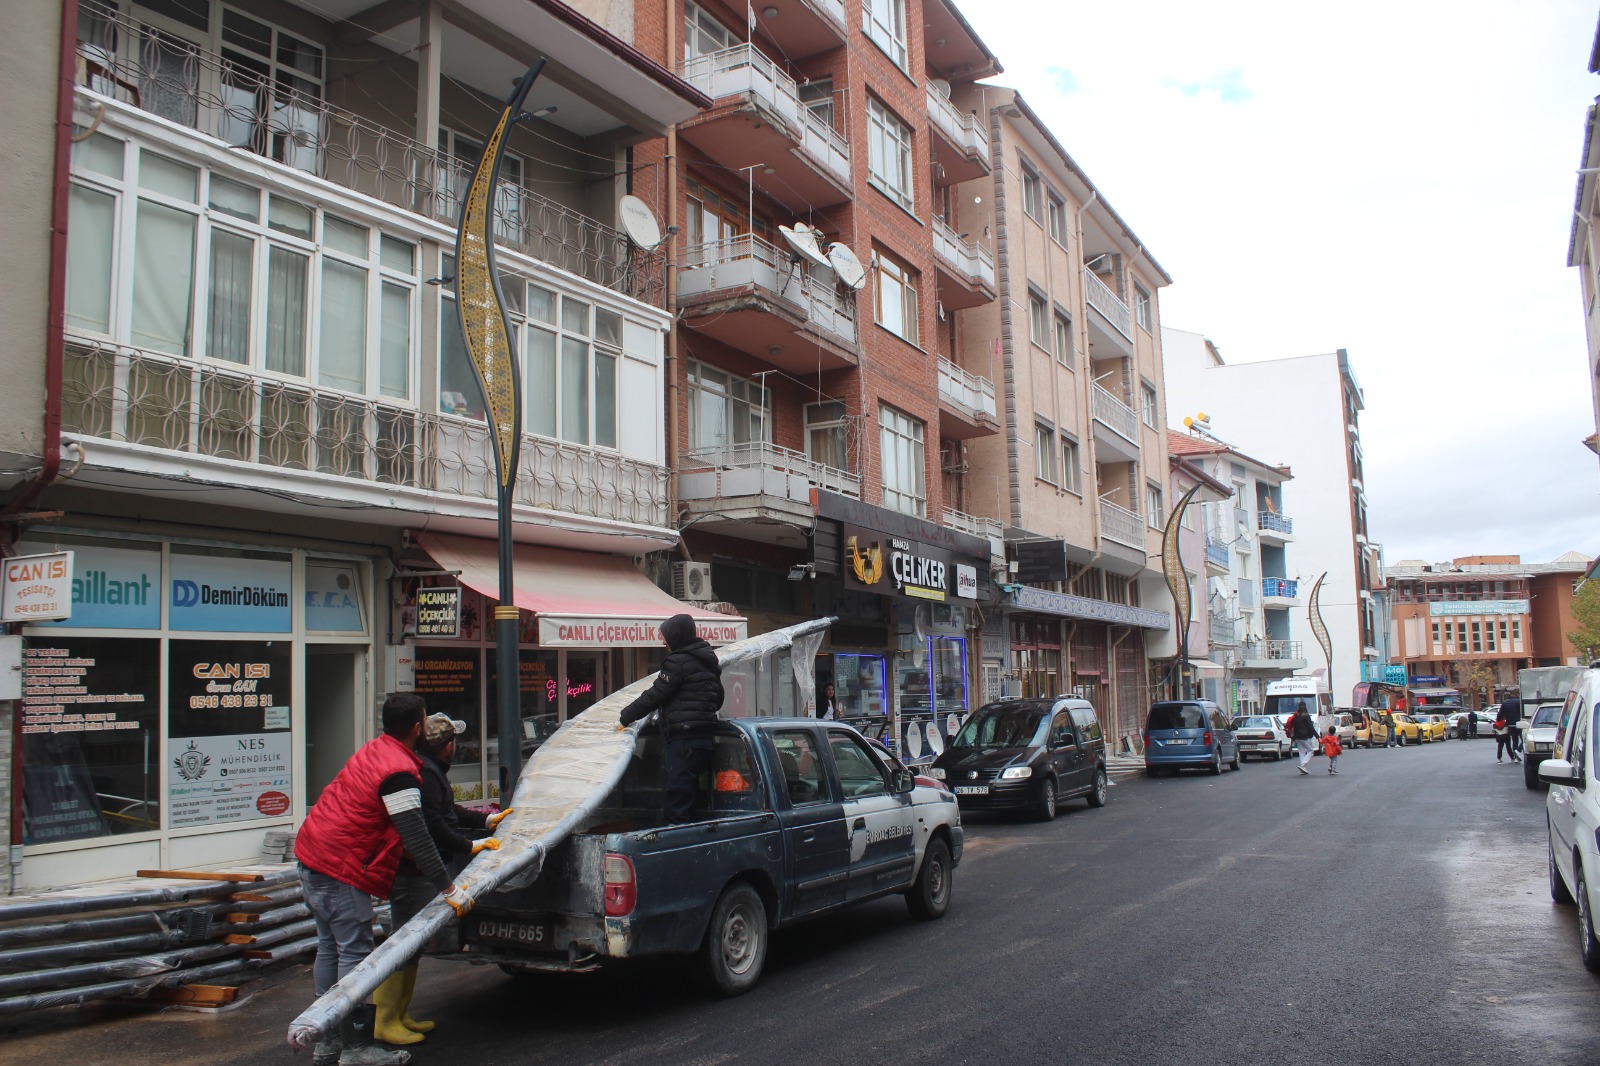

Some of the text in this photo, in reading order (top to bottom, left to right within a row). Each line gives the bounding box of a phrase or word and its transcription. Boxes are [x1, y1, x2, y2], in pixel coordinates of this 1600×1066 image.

[892, 538, 910, 551] HAMZA
[8, 560, 66, 582] CAN ISI
[71, 570, 151, 606] aillant
[201, 584, 288, 607] DemirDöküm
[427, 592, 449, 604] CANLI
[559, 624, 594, 641] CANLI
[596, 621, 655, 643] ÇİÇEKÇİLİK
[193, 663, 270, 679] CAN ISI
[424, 658, 474, 670] ORGANİZASYON
[232, 679, 258, 693] CAN
[190, 694, 273, 709] 0546 438 23 31
[238, 738, 265, 750] NES
[221, 753, 281, 765] MÜHENDİSLİK
[479, 921, 544, 941] 03 HF 665
